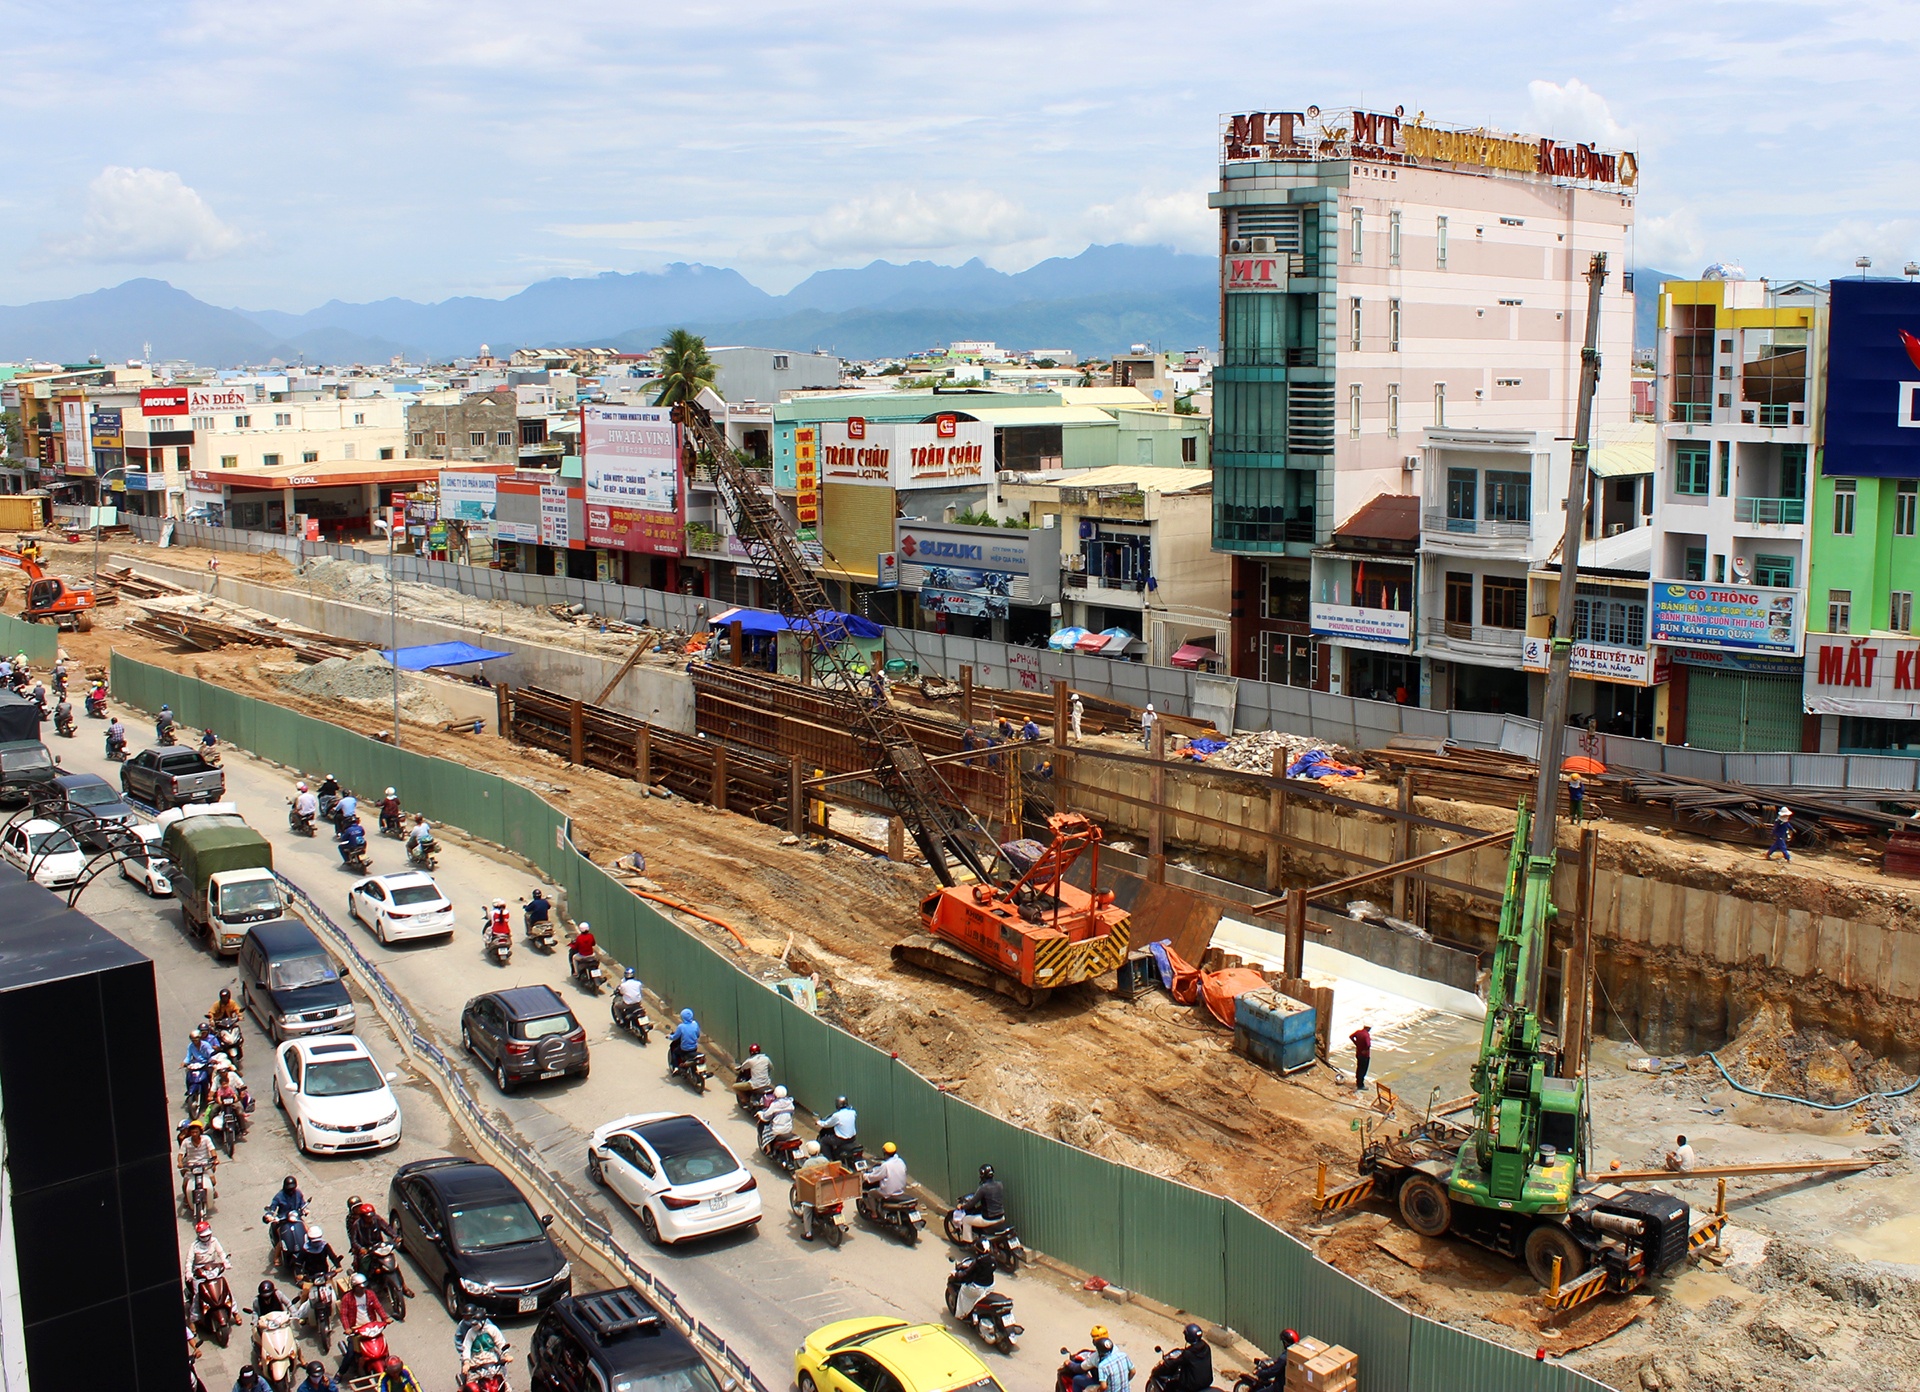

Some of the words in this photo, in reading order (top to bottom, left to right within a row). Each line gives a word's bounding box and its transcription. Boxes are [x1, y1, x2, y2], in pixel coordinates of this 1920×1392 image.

[1540, 137, 1575, 177] KIM
[1229, 259, 1276, 281] MT
[143, 397, 176, 407] MOTUL
[190, 391, 209, 405] ÂN
[608, 429, 644, 444] HWATA
[646, 431, 671, 446] VINA
[825, 442, 854, 467] TRÂN
[857, 443, 889, 468] CHÂU
[911, 442, 945, 467] TRÂN
[948, 440, 983, 465] CHÂU
[287, 476, 318, 485] TOTAL
[919, 540, 982, 560] SUZUKI
[1688, 589, 1707, 601] CÔ
[1710, 590, 1759, 605] THÔNG
[1660, 600, 1685, 611] BÁNH
[1328, 622, 1354, 631] PHƯỜNG
[1660, 611, 1681, 621] BÁNH
[1732, 617, 1748, 628] THỊT
[1750, 619, 1765, 629] HEO
[1660, 621, 1679, 632] BÚN
[1706, 626, 1725, 636] HEO
[1727, 629, 1755, 639] QUAY
[1571, 646, 1588, 658] ƯỜI
[1590, 649, 1627, 663] KHUYẾT
[1629, 654, 1646, 667] TẬT
[1582, 657, 1595, 668] PHỐ
[1690, 648, 1723, 662] THÔNG
[1818, 638, 1877, 687] MẮT
[243, 914, 264, 922] JAC
[1072, 939, 1108, 955] TACHI
